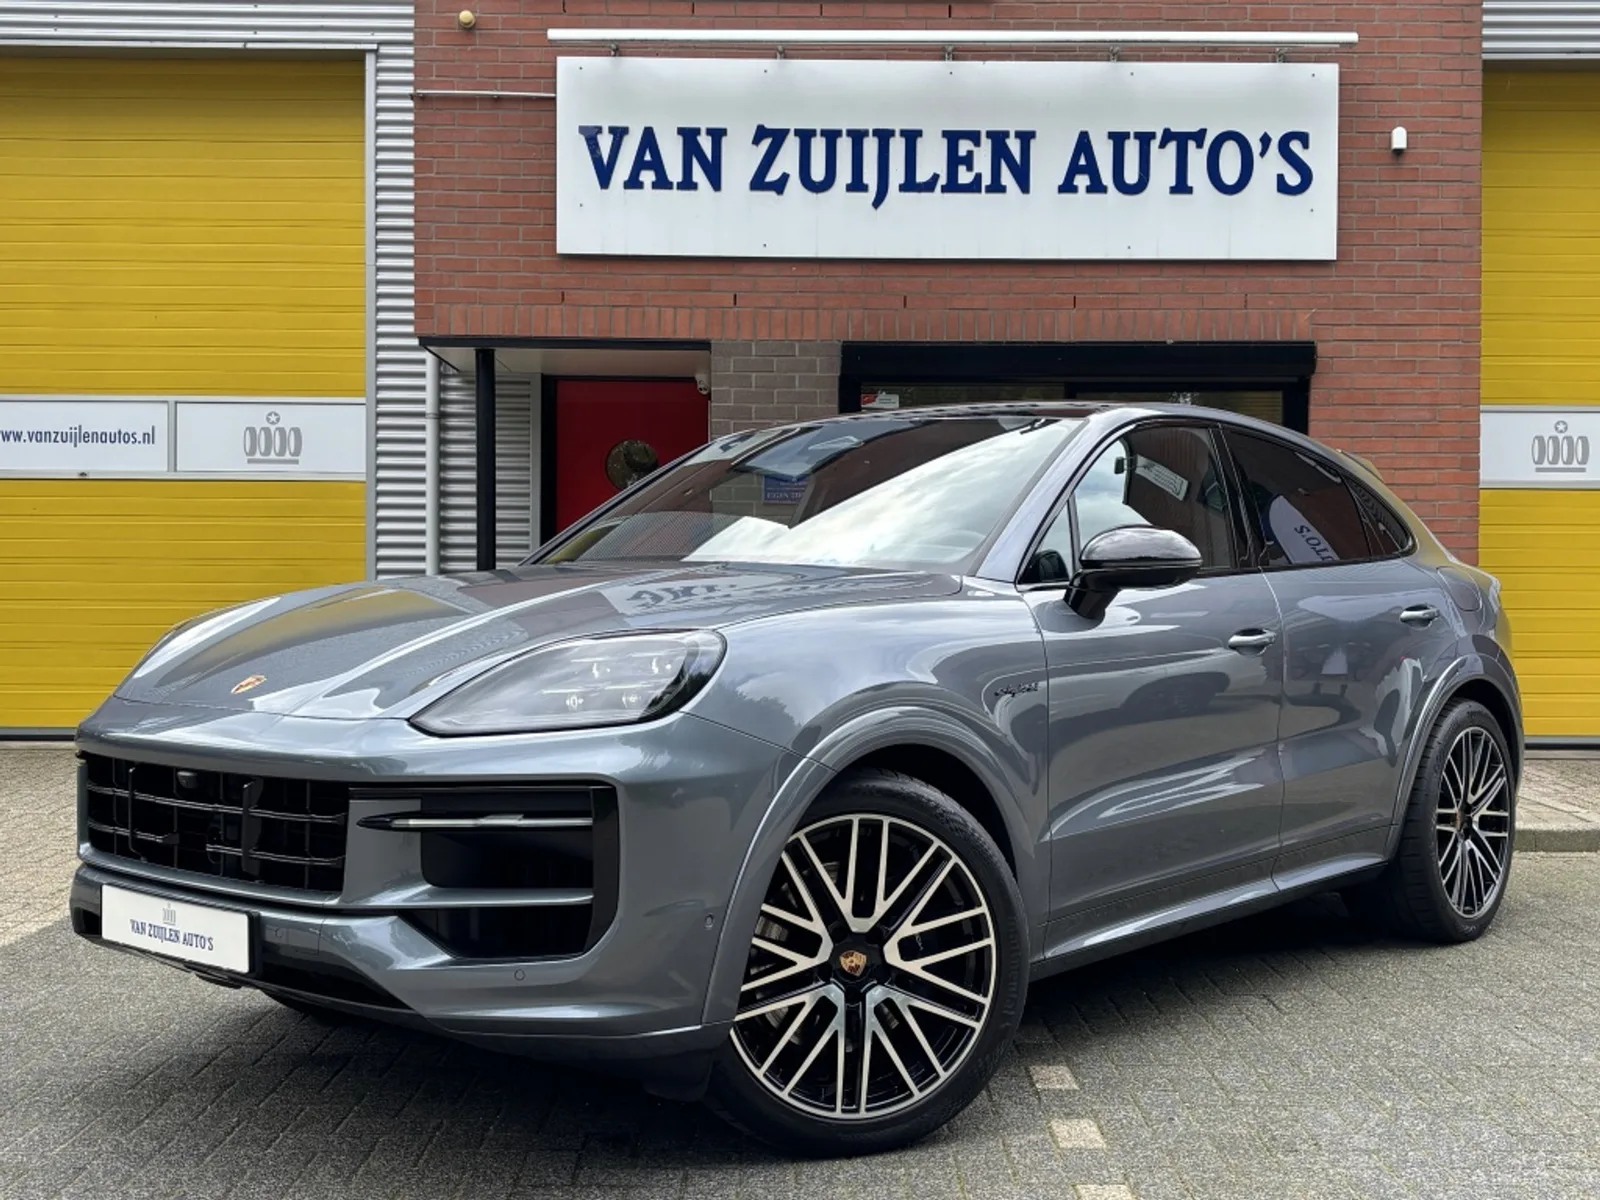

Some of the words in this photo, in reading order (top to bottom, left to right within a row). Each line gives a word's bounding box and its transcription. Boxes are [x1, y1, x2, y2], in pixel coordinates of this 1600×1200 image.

[578, 125, 728, 192] VAN
[749, 124, 1036, 210] ZUIJLEN
[1057, 128, 1314, 196] AUTO'S
[0, 425, 155, 448] ww.vanzuijlenautos.nl
[129, 919, 147, 935] VAN
[148, 923, 181, 943] ZUIJLEN
[182, 931, 214, 951] AUTO'S
